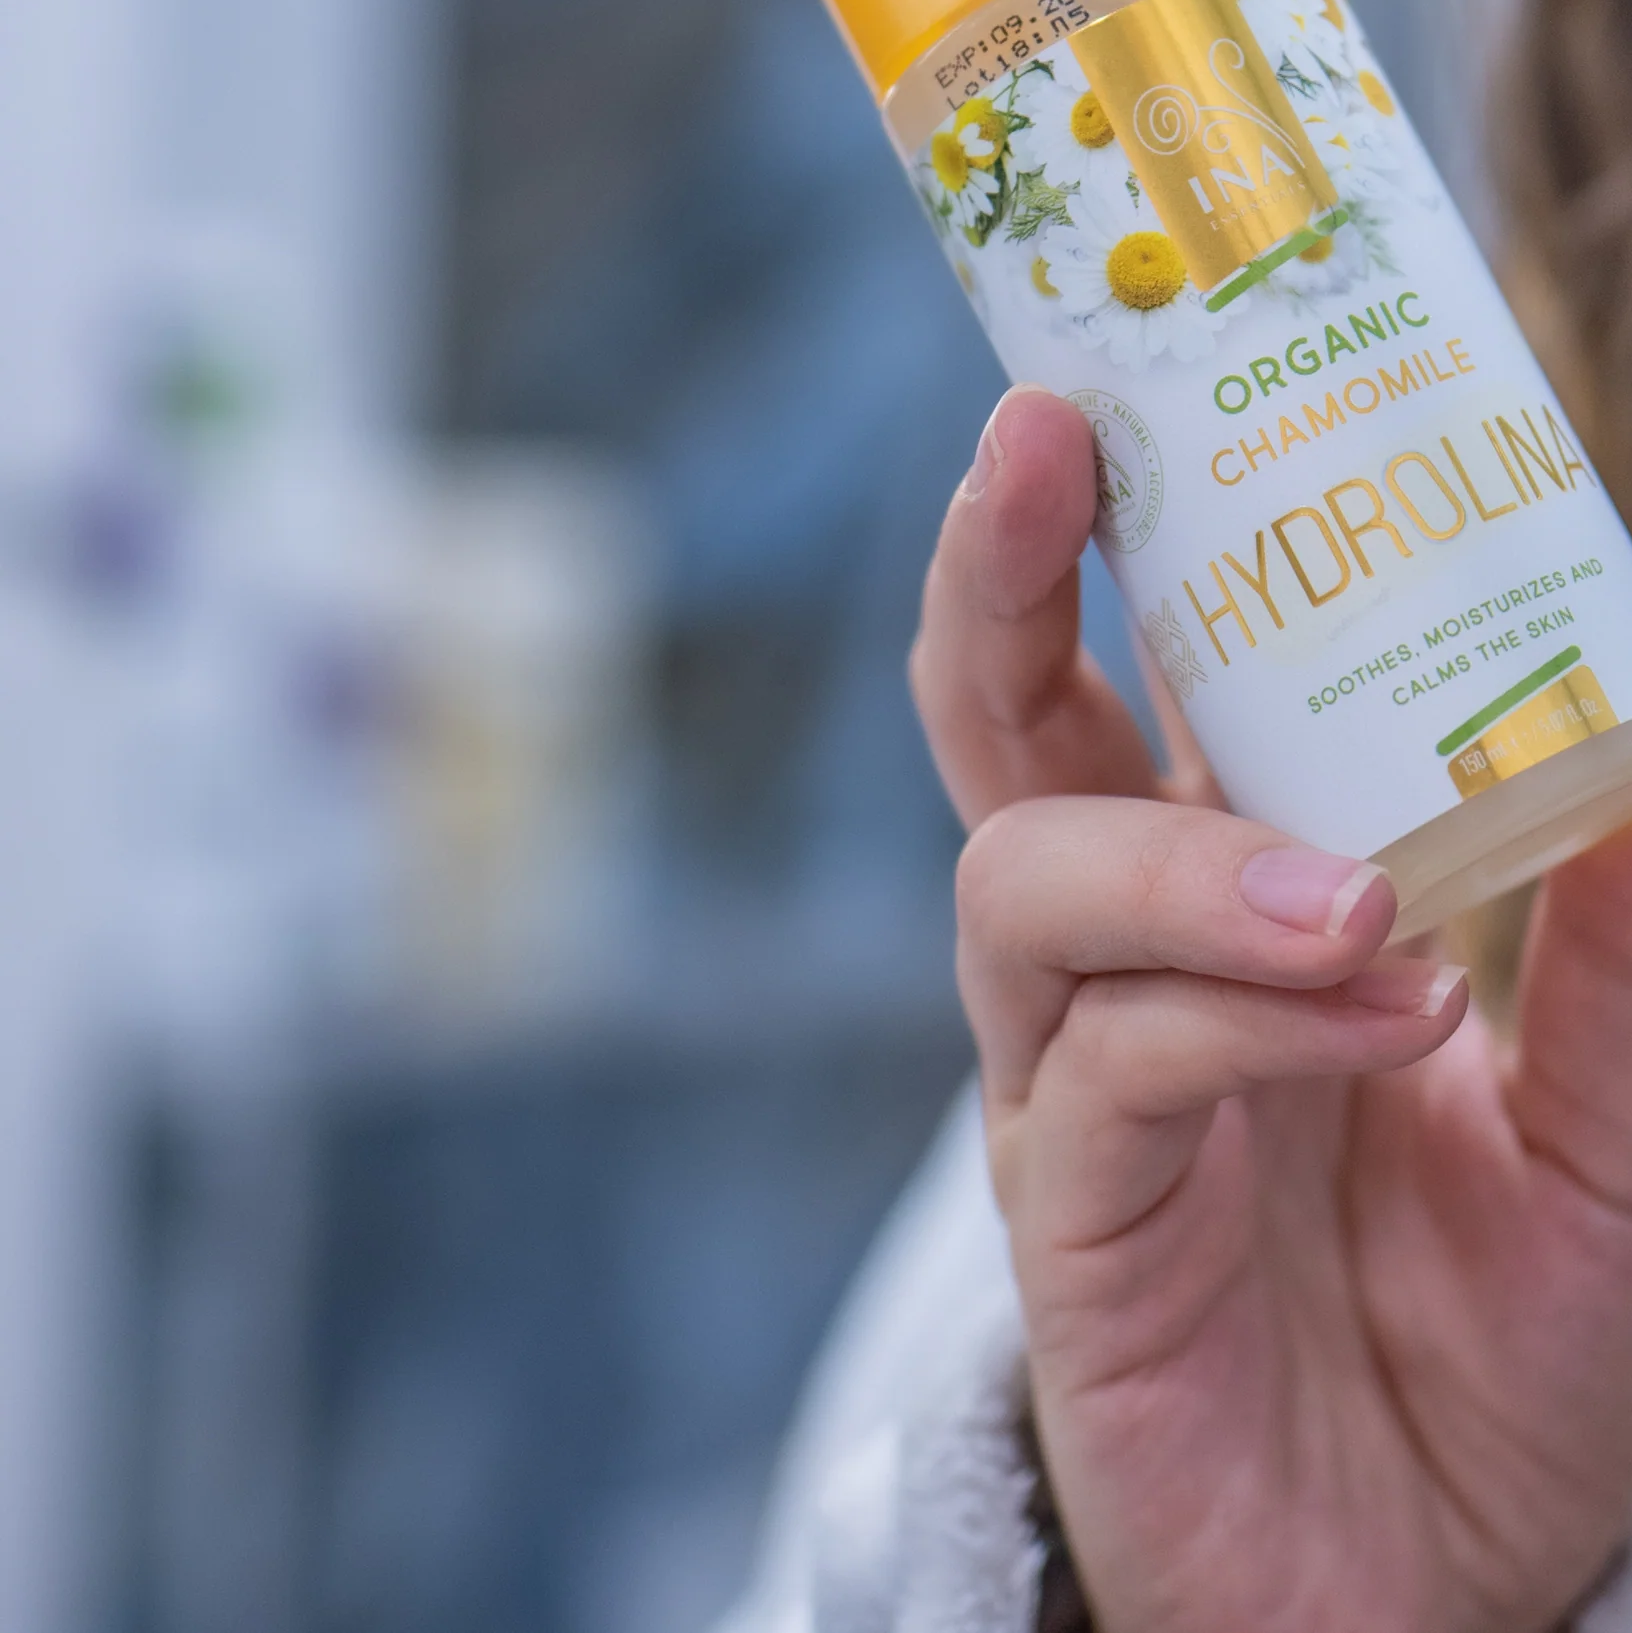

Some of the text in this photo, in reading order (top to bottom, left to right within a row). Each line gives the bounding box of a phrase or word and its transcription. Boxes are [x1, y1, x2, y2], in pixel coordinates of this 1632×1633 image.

[1188, 144, 1295, 214] INA
[1213, 291, 1430, 414] ORGANIC
[1112, 402, 1152, 454] NATURAL
[1211, 338, 1477, 486] CHAMOMILE
[1182, 403, 1598, 667] HYDROLINA
[1307, 558, 1604, 714] SOOTHES, MOISTURIZES AND
[1392, 606, 1575, 706] CALMS THE SKIN
[1458, 750, 1487, 777] 150
